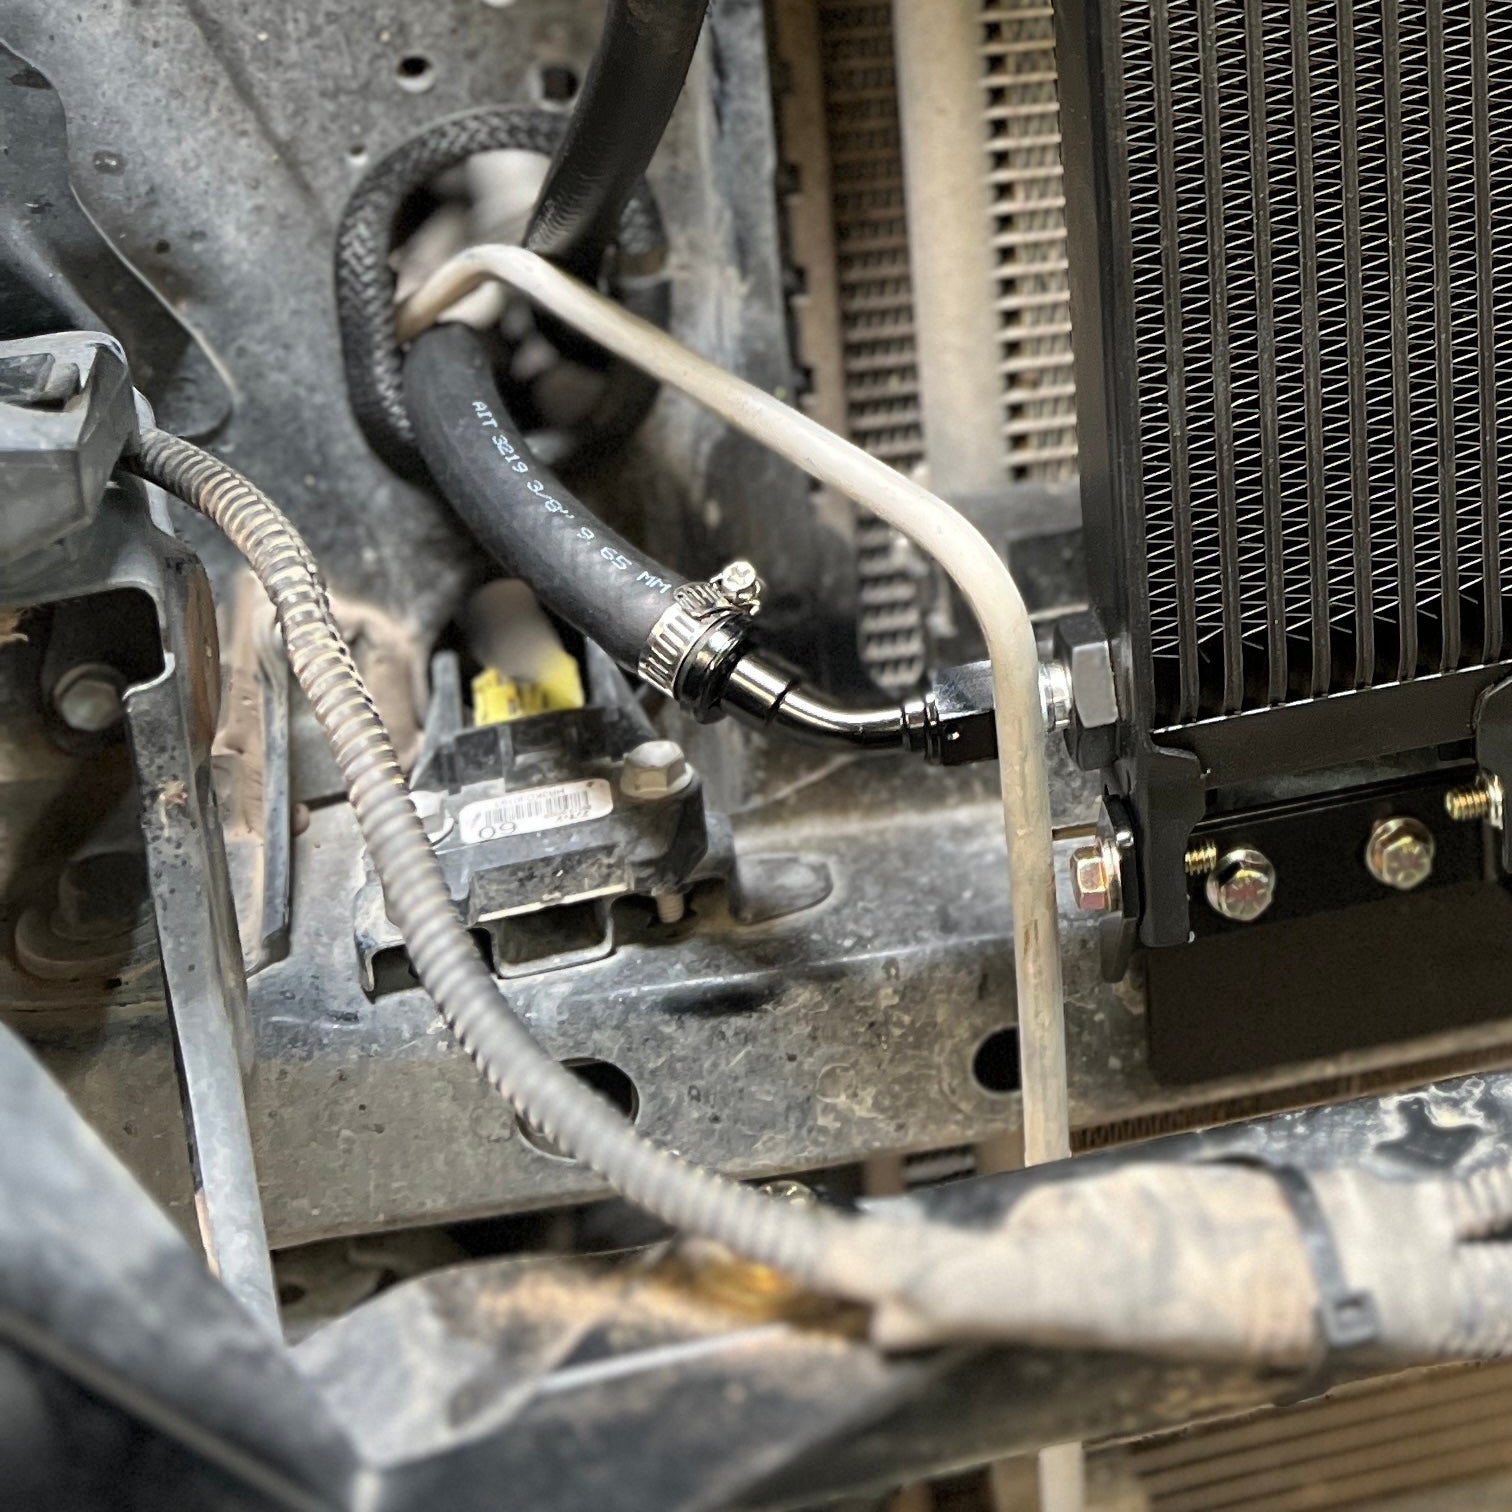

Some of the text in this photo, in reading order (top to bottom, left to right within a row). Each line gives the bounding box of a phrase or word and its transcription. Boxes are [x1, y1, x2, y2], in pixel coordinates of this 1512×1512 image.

[491, 434, 529, 473] 3219
[600, 546, 633, 570] 65
[636, 570, 672, 594] MM
